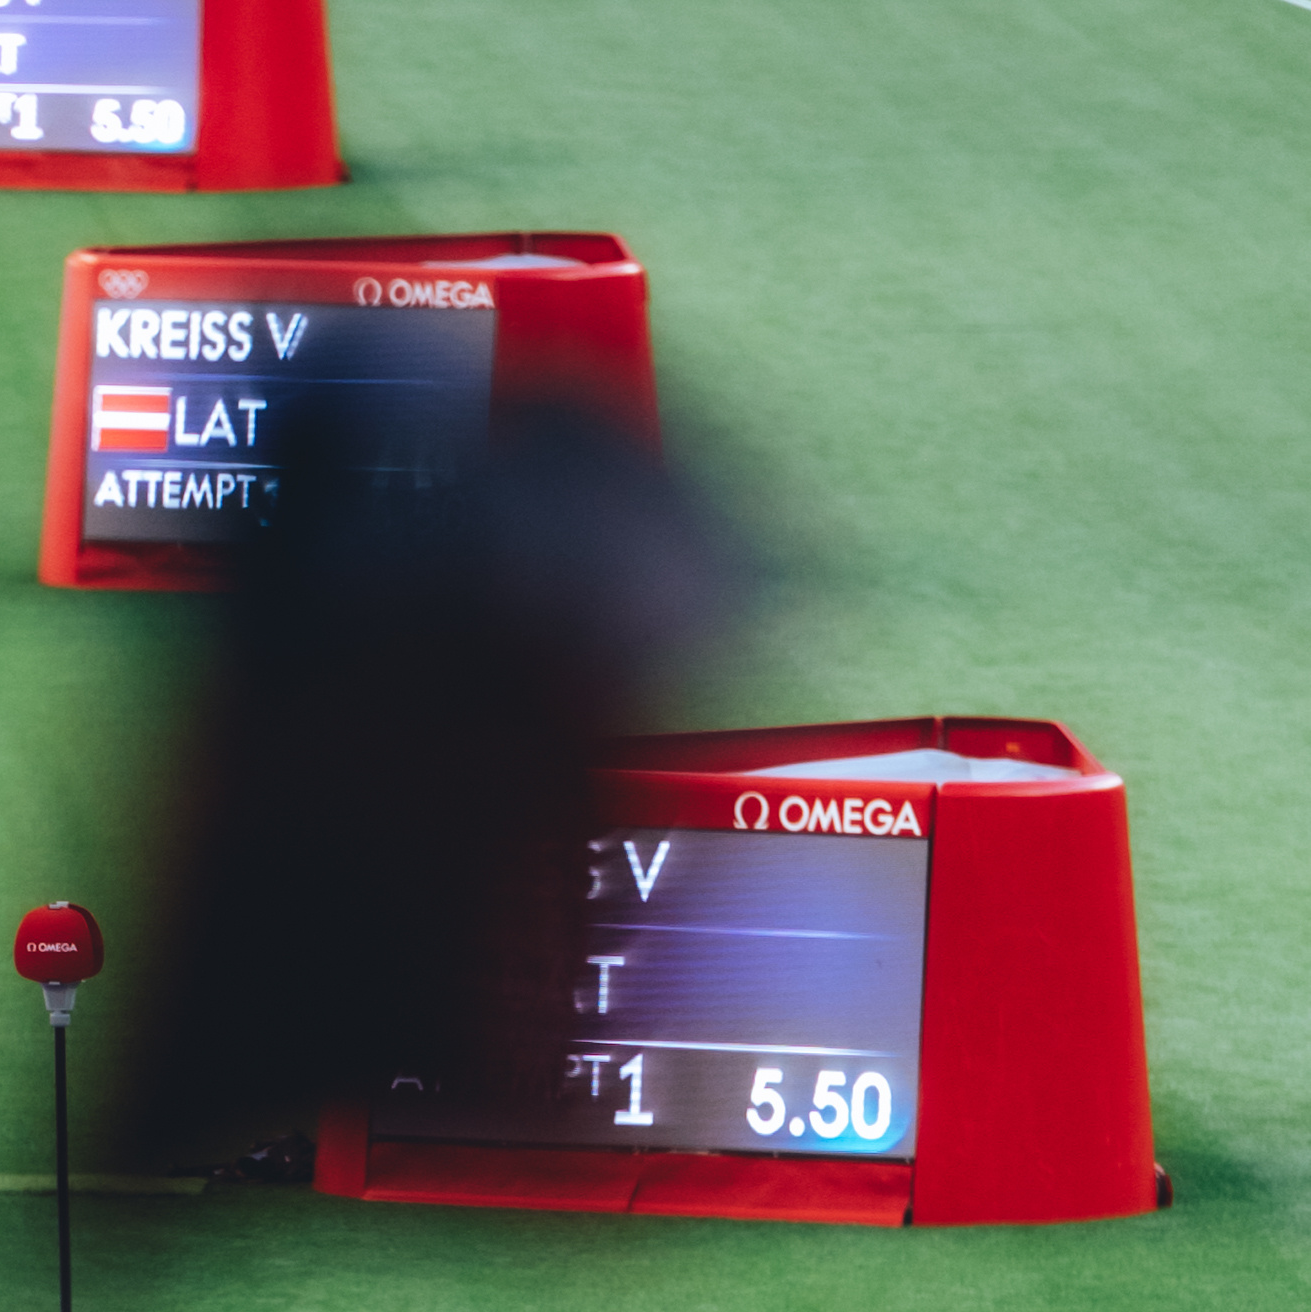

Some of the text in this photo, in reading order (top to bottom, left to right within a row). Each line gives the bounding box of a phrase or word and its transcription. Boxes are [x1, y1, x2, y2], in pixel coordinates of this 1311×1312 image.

[90, 98, 186, 143] 5.50
[389, 278, 496, 309] OMEGA
[96, 308, 308, 361] KREISS V
[175, 395, 267, 447] LAT
[94, 470, 257, 509] ATTEMPT
[780, 795, 921, 836] OMEGA
[623, 840, 671, 902] V
[38, 942, 78, 953] OMEGA
[614, 1053, 654, 1126] 1
[746, 1067, 892, 1141] 5.50
